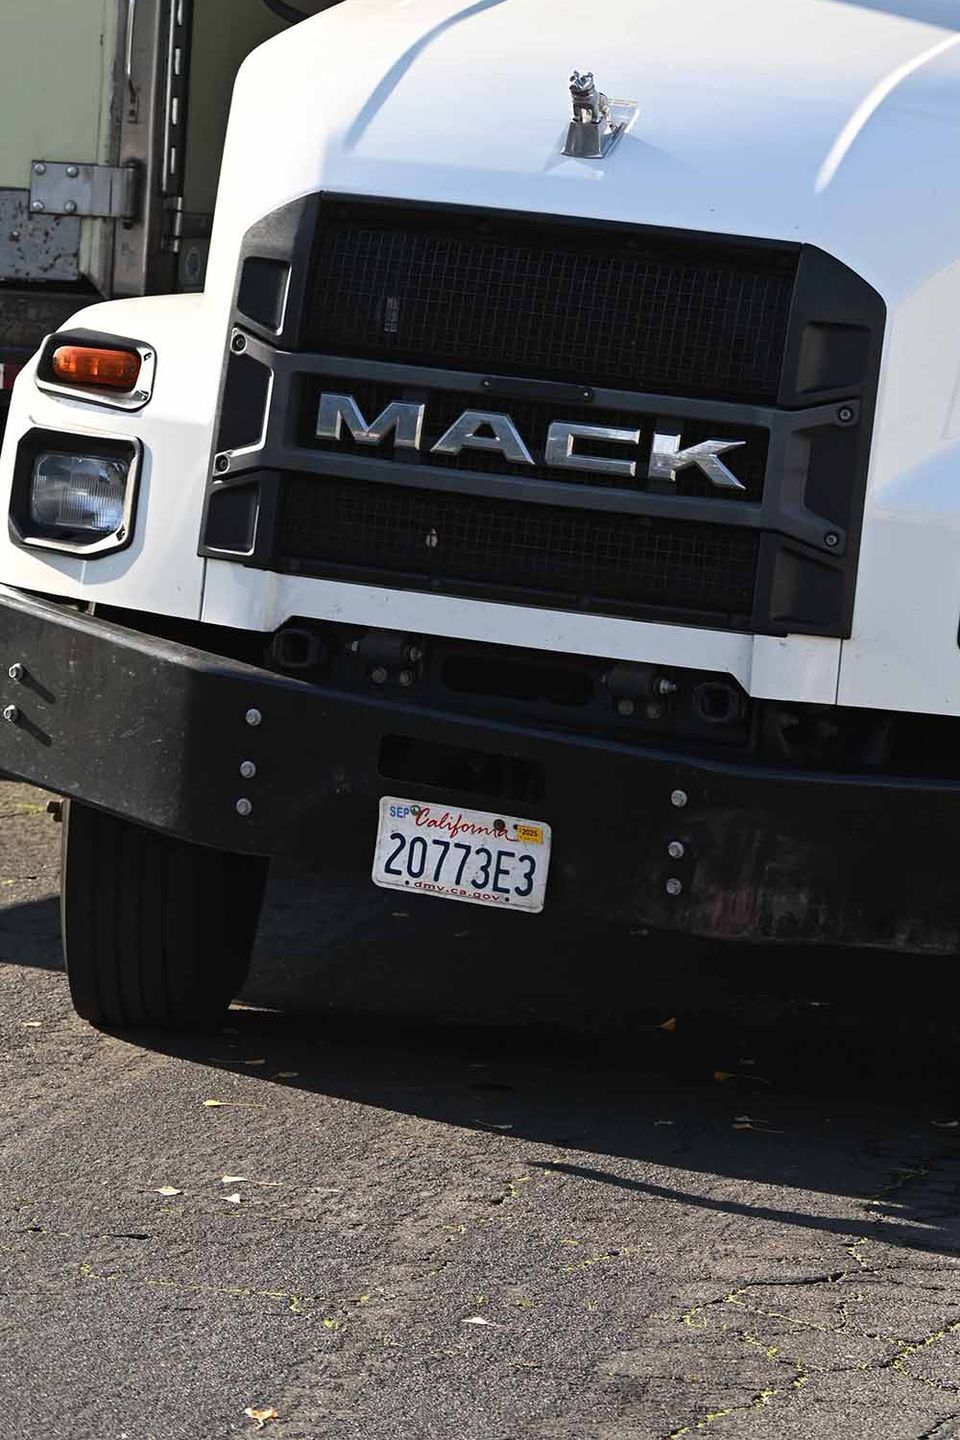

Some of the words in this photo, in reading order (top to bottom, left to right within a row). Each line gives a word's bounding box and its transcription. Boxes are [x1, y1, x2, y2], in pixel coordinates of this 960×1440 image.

[316, 392, 747, 490] MACK
[389, 805, 410, 818] SEP
[413, 807, 520, 843] California
[384, 832, 537, 897] 20773E3
[414, 880, 501, 901] dmv.ca.gov
